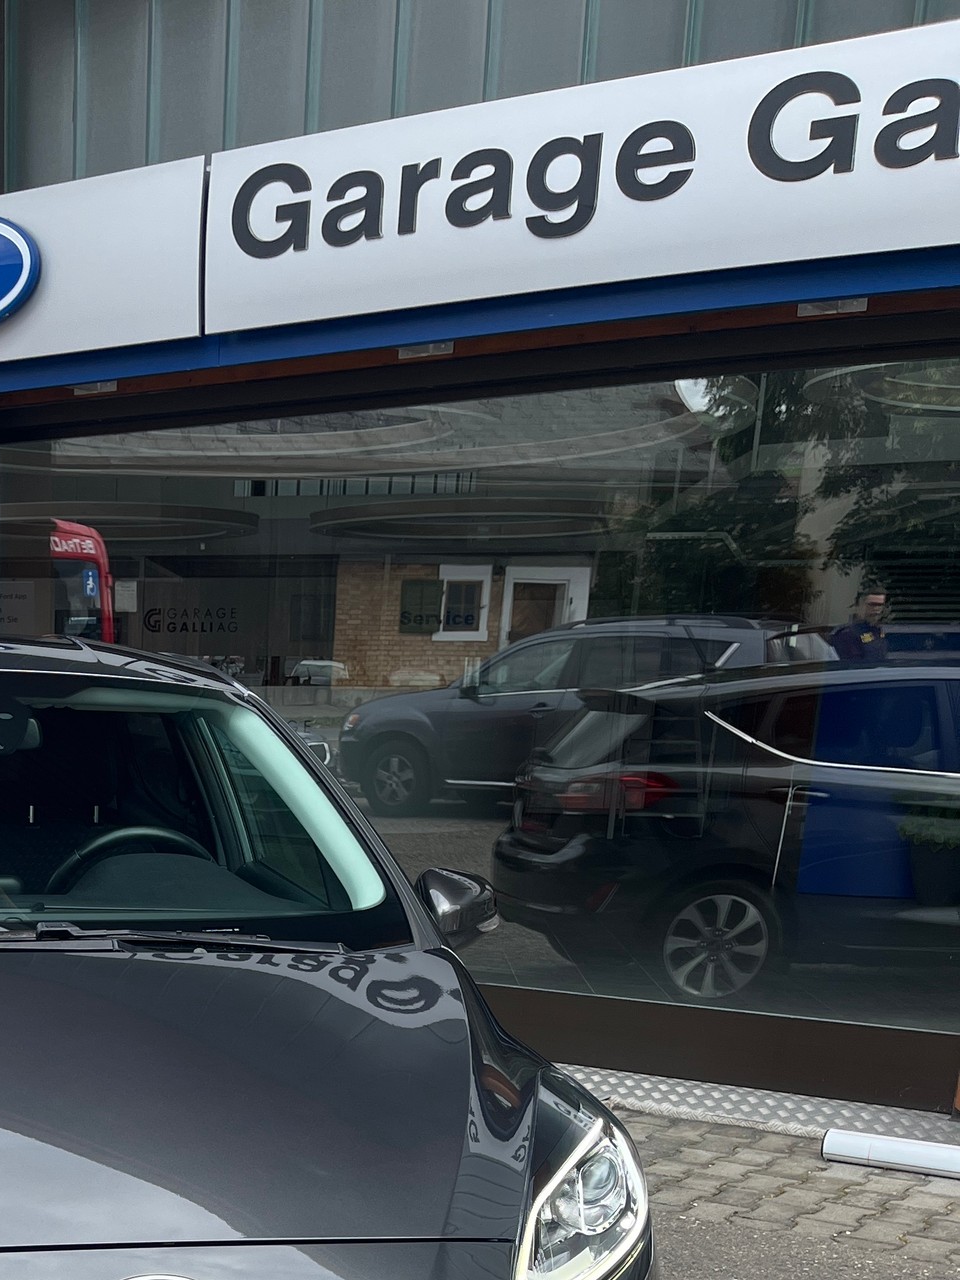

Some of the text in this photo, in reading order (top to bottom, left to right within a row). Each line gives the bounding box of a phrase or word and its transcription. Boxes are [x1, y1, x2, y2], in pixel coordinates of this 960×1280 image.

[231, 70, 960, 260] Garage Ga
[166, 607, 237, 619] GARAGE
[166, 621, 238, 633] GALLI AG
